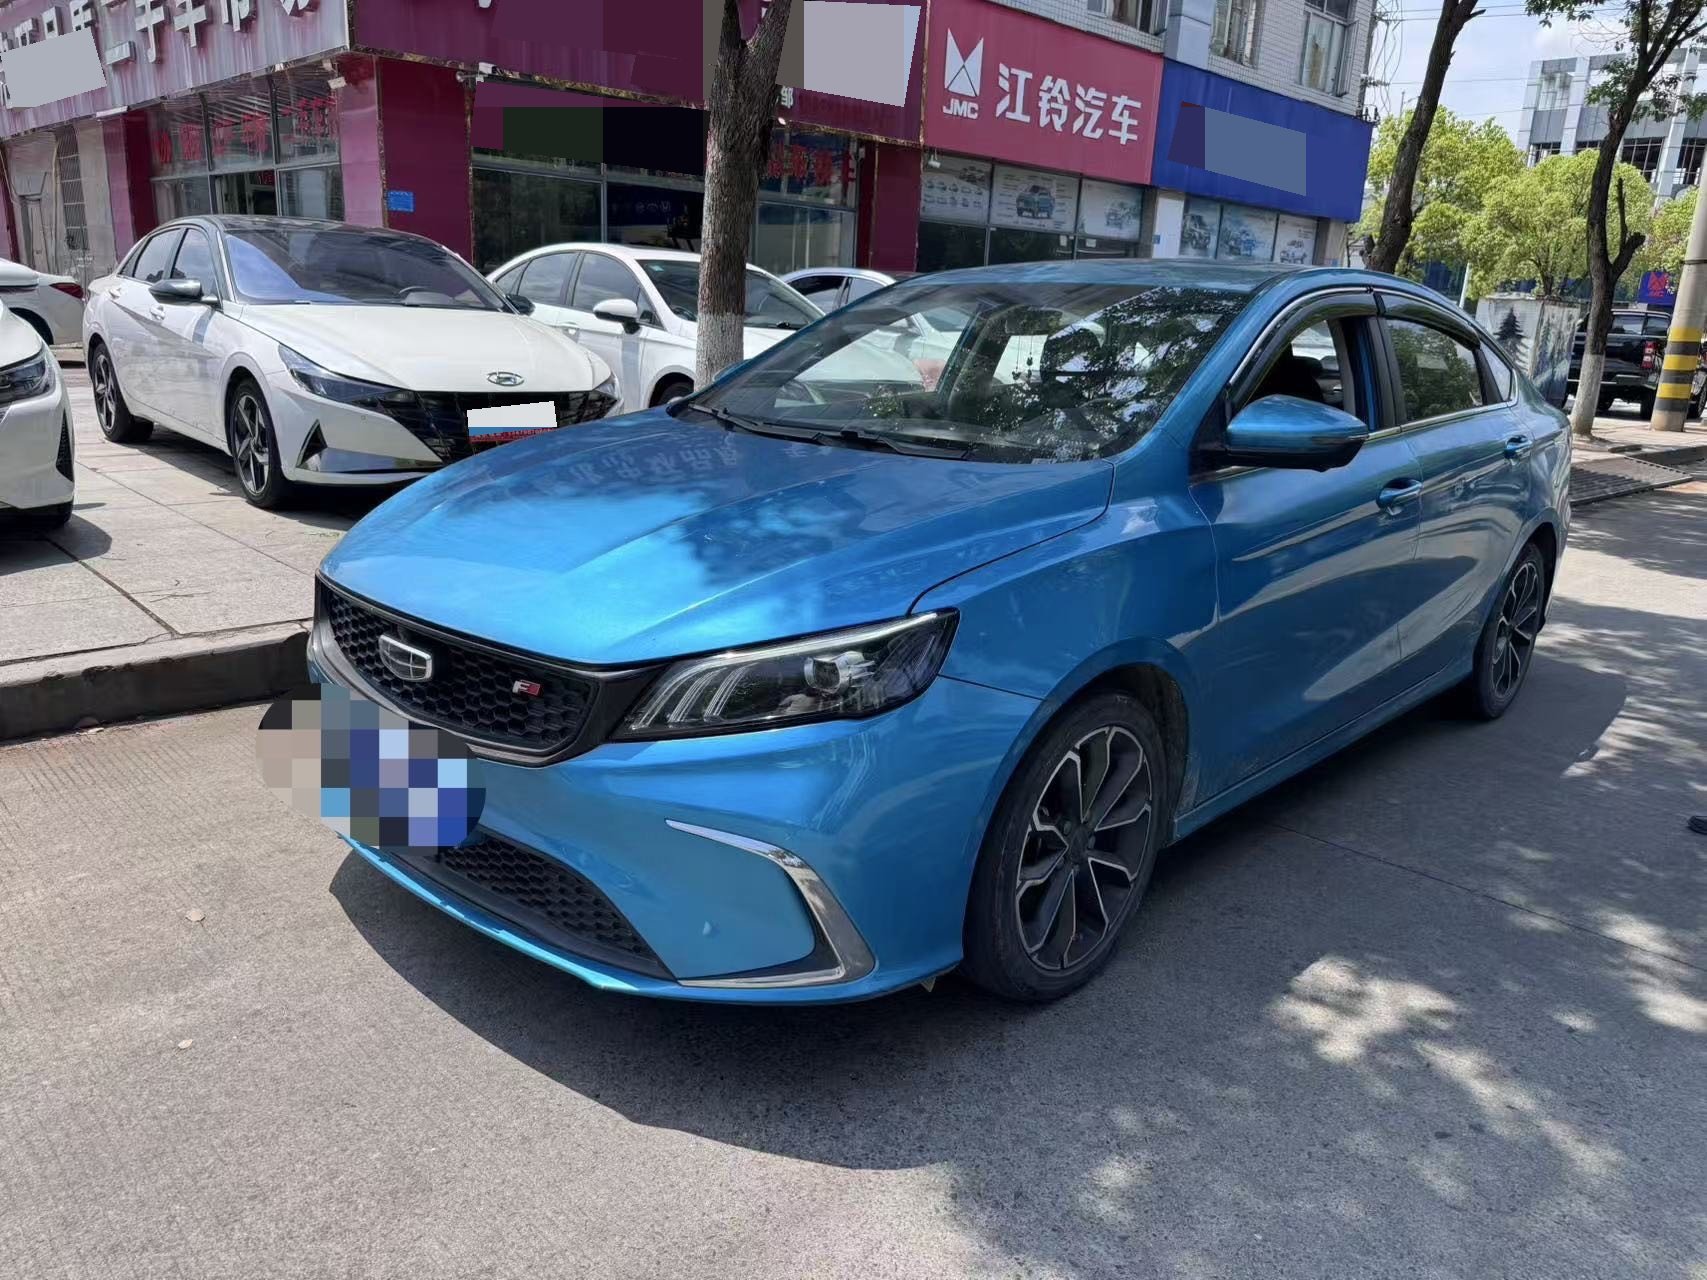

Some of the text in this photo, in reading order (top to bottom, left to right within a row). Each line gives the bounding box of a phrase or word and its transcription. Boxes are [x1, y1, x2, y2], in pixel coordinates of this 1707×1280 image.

[942, 98, 980, 120] JMC
[995, 62, 1142, 146] 江铃汽车
